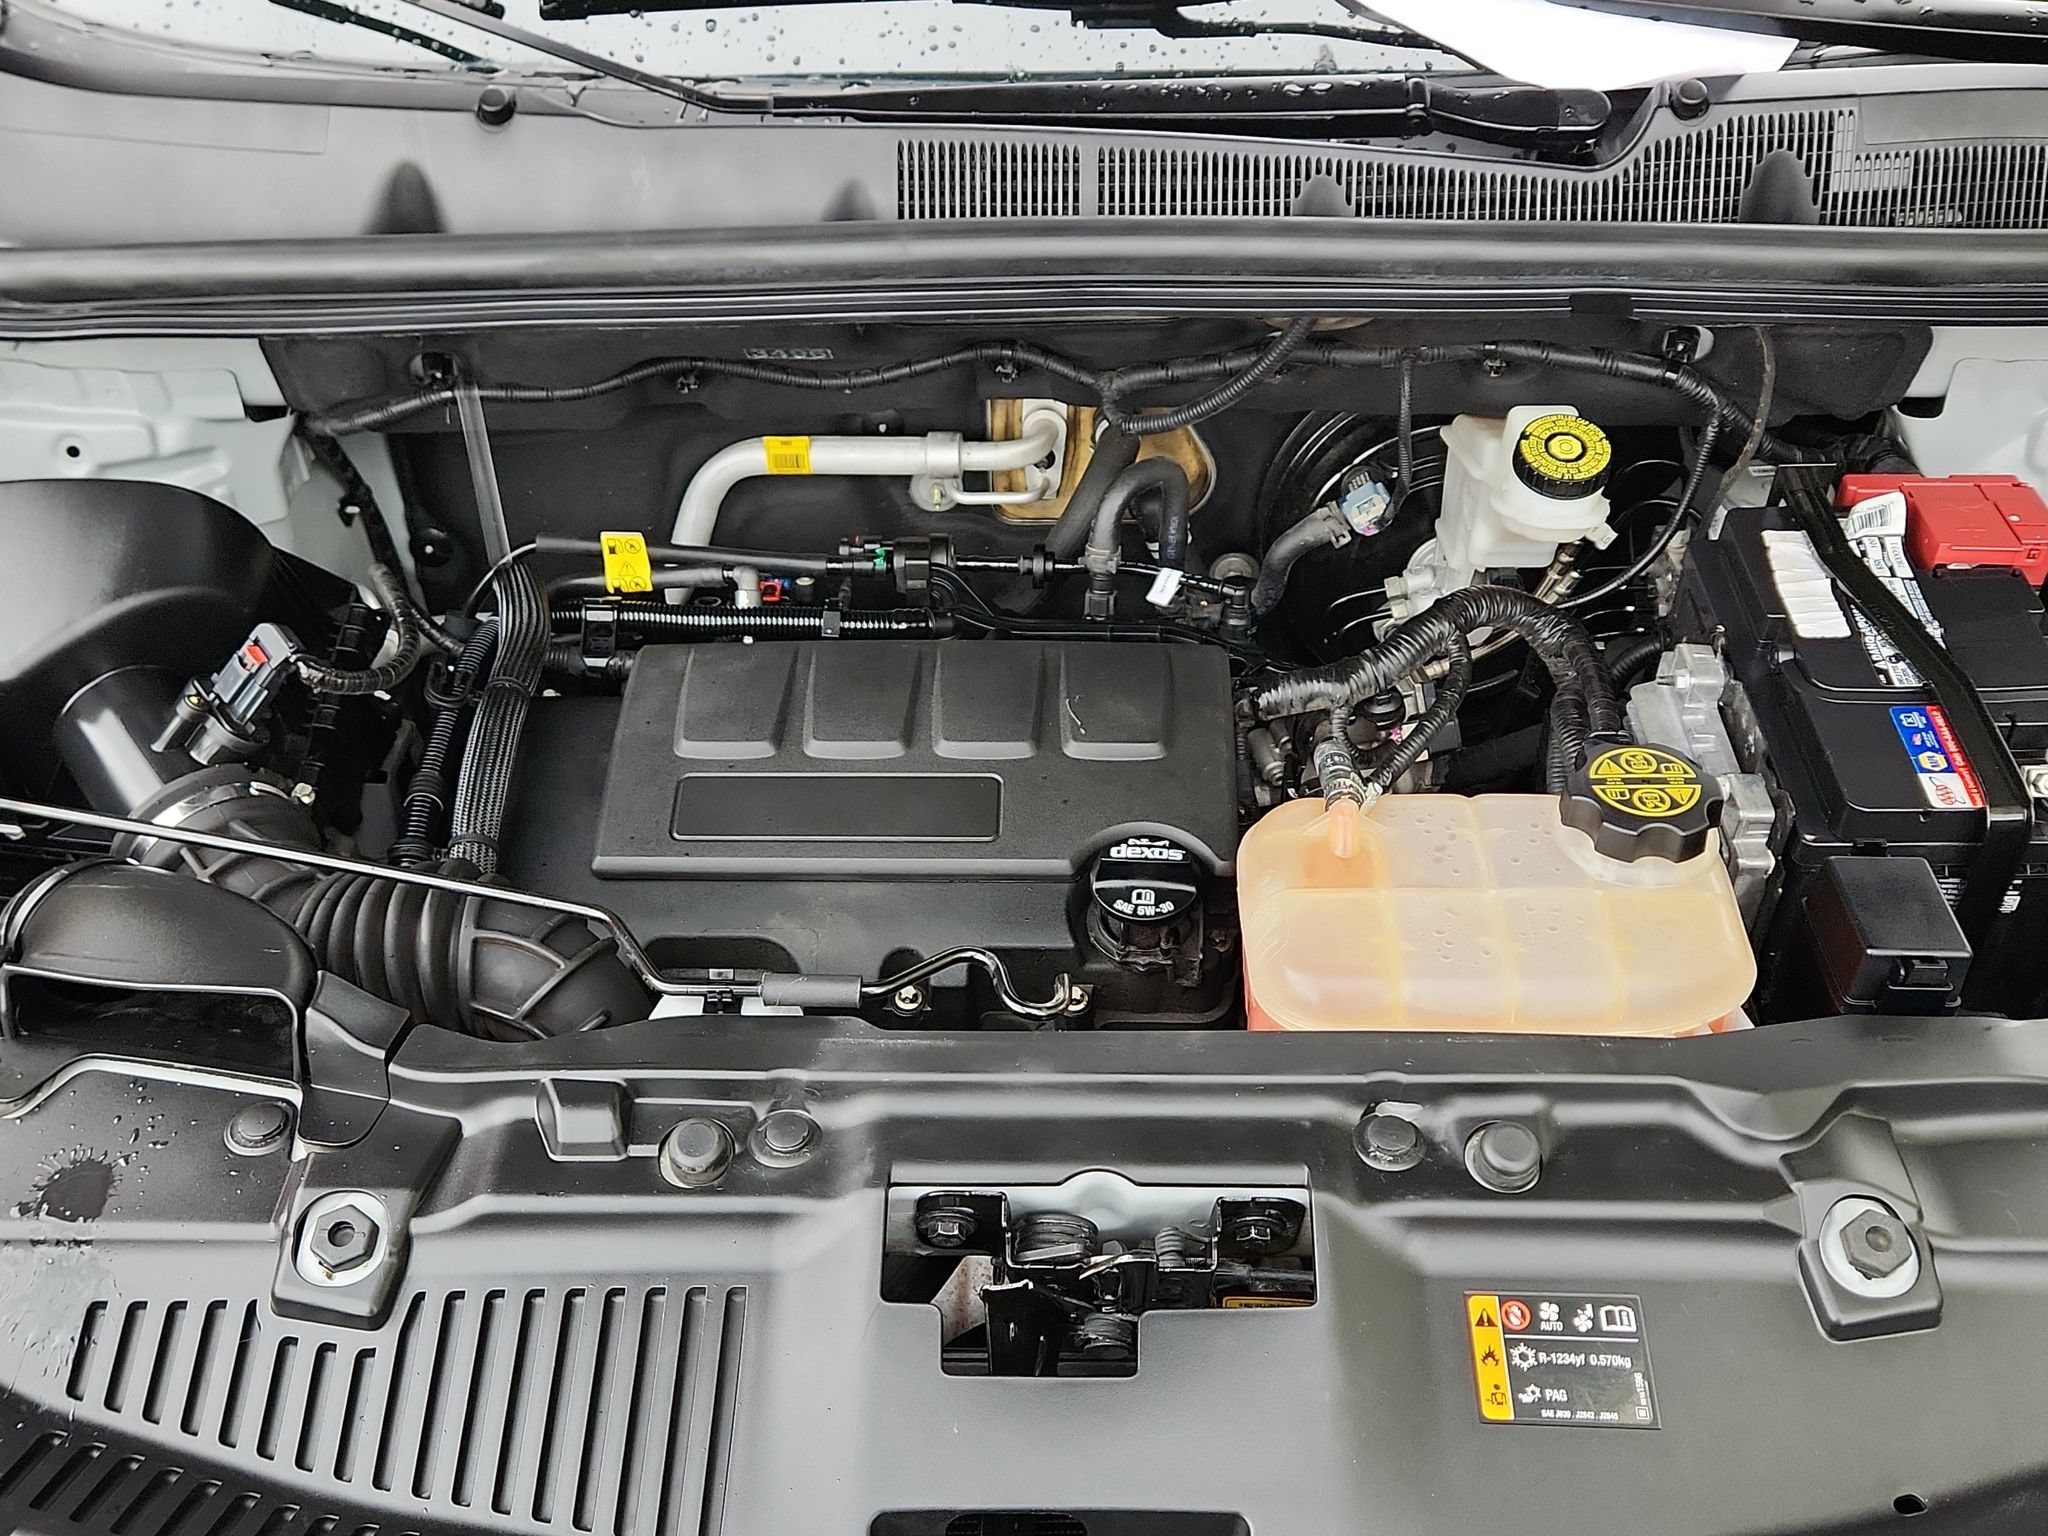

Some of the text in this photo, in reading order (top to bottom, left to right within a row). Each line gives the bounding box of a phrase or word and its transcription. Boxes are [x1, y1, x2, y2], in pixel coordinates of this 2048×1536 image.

[1109, 843, 1186, 861] dexos
[1112, 899, 1175, 917] SAE 5W-30
[1540, 1321, 1564, 1332] AUTO
[1545, 1388, 1568, 1402] PAG
